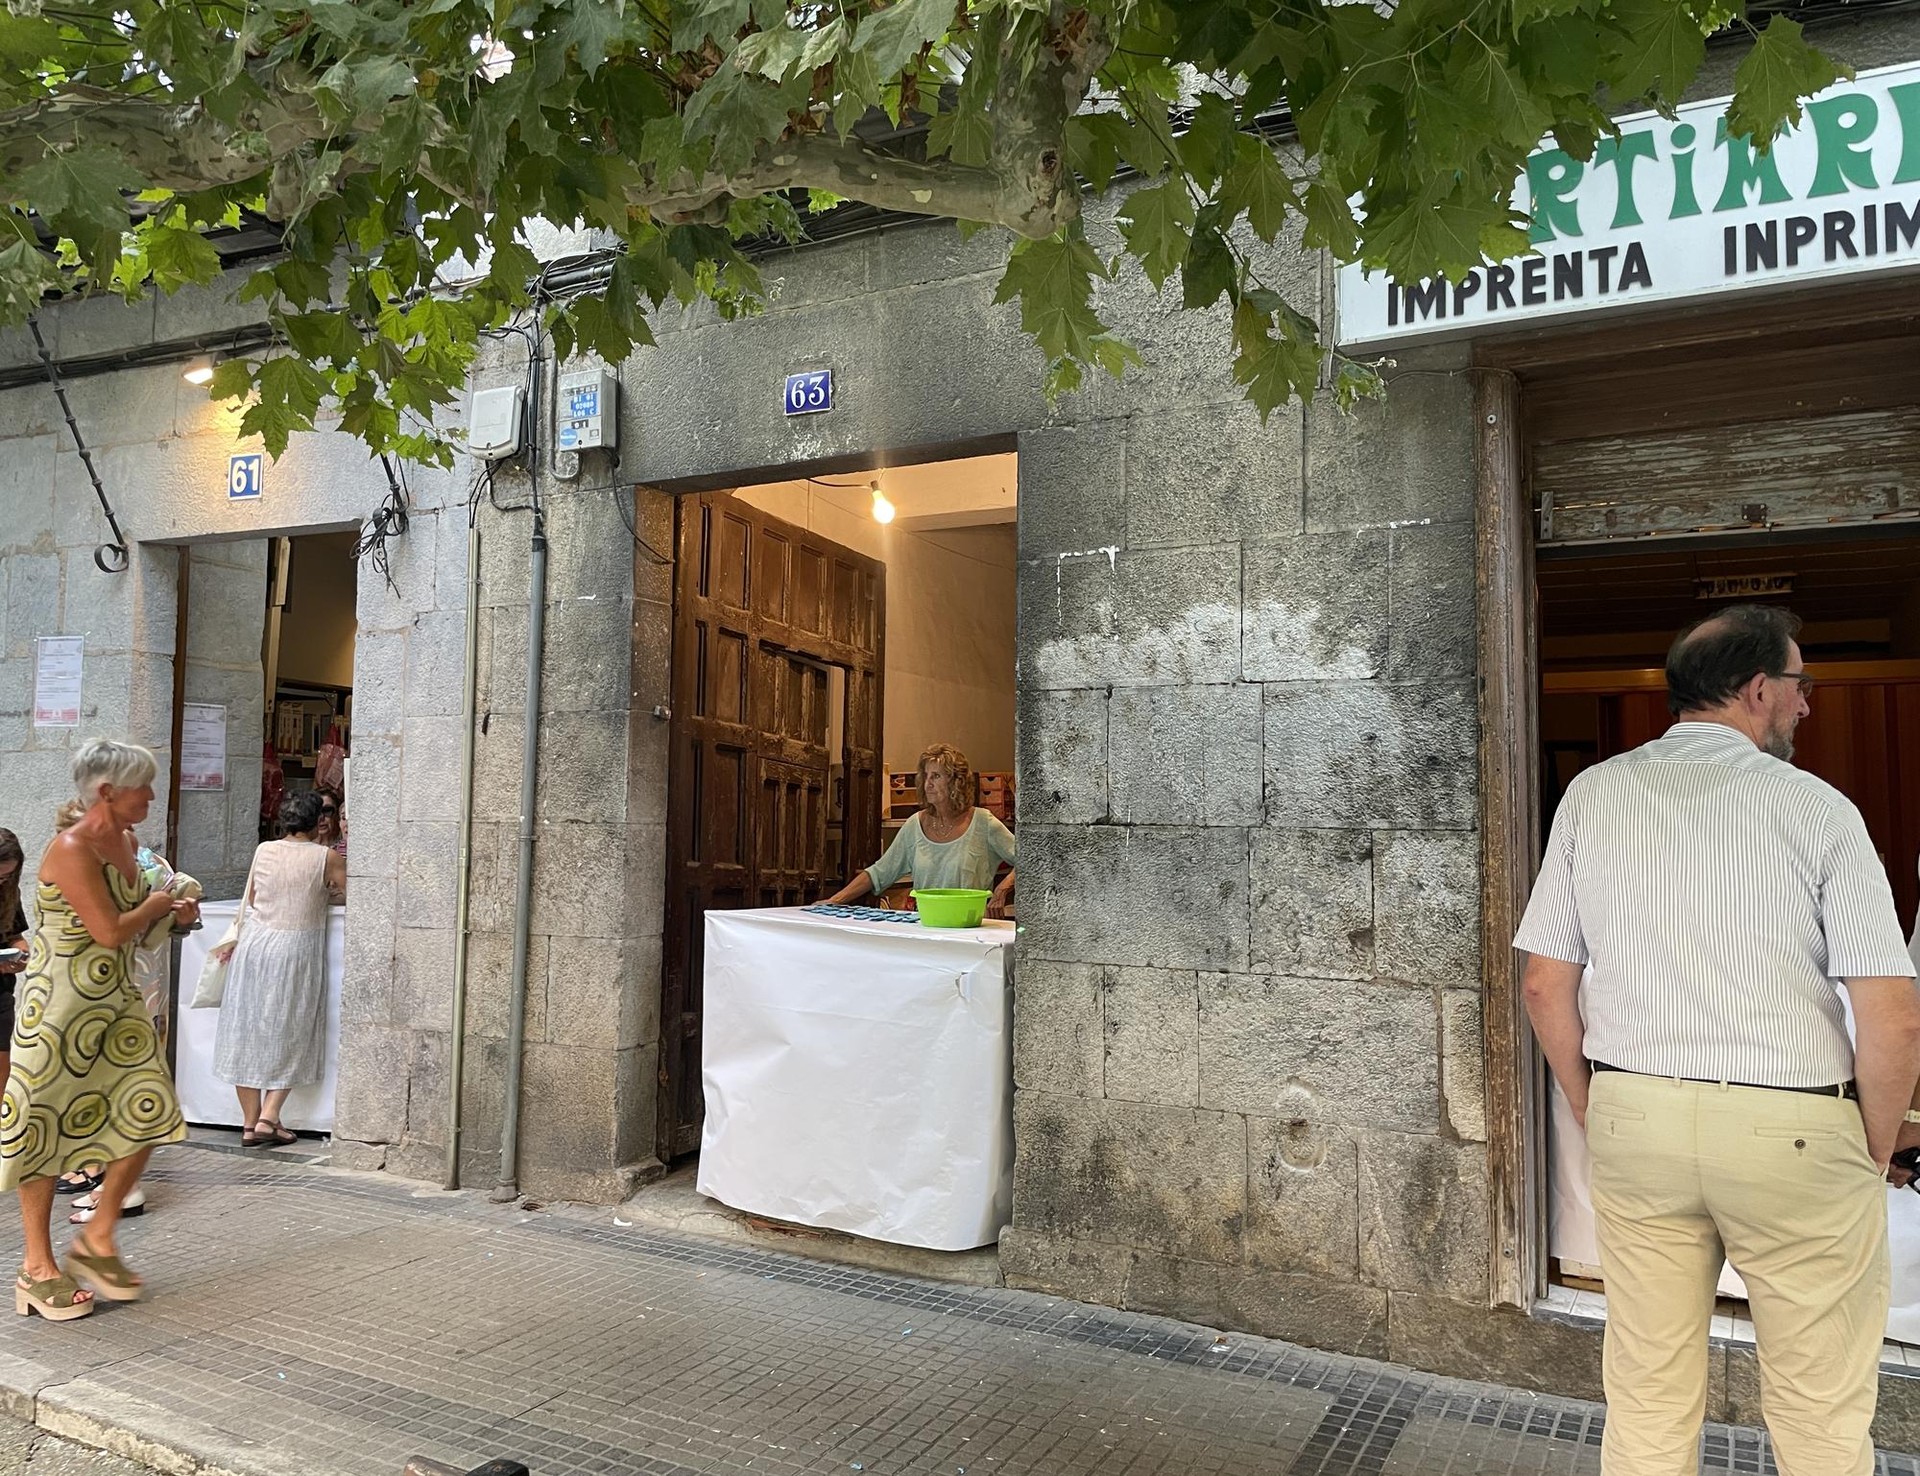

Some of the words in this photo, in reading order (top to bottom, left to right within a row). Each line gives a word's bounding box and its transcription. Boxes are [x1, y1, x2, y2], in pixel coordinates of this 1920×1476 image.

[1387, 241, 1653, 327] IMPRENTA
[1724, 199, 1920, 276] INPRIM
[791, 375, 825, 409] 63
[231, 458, 260, 493] 61
